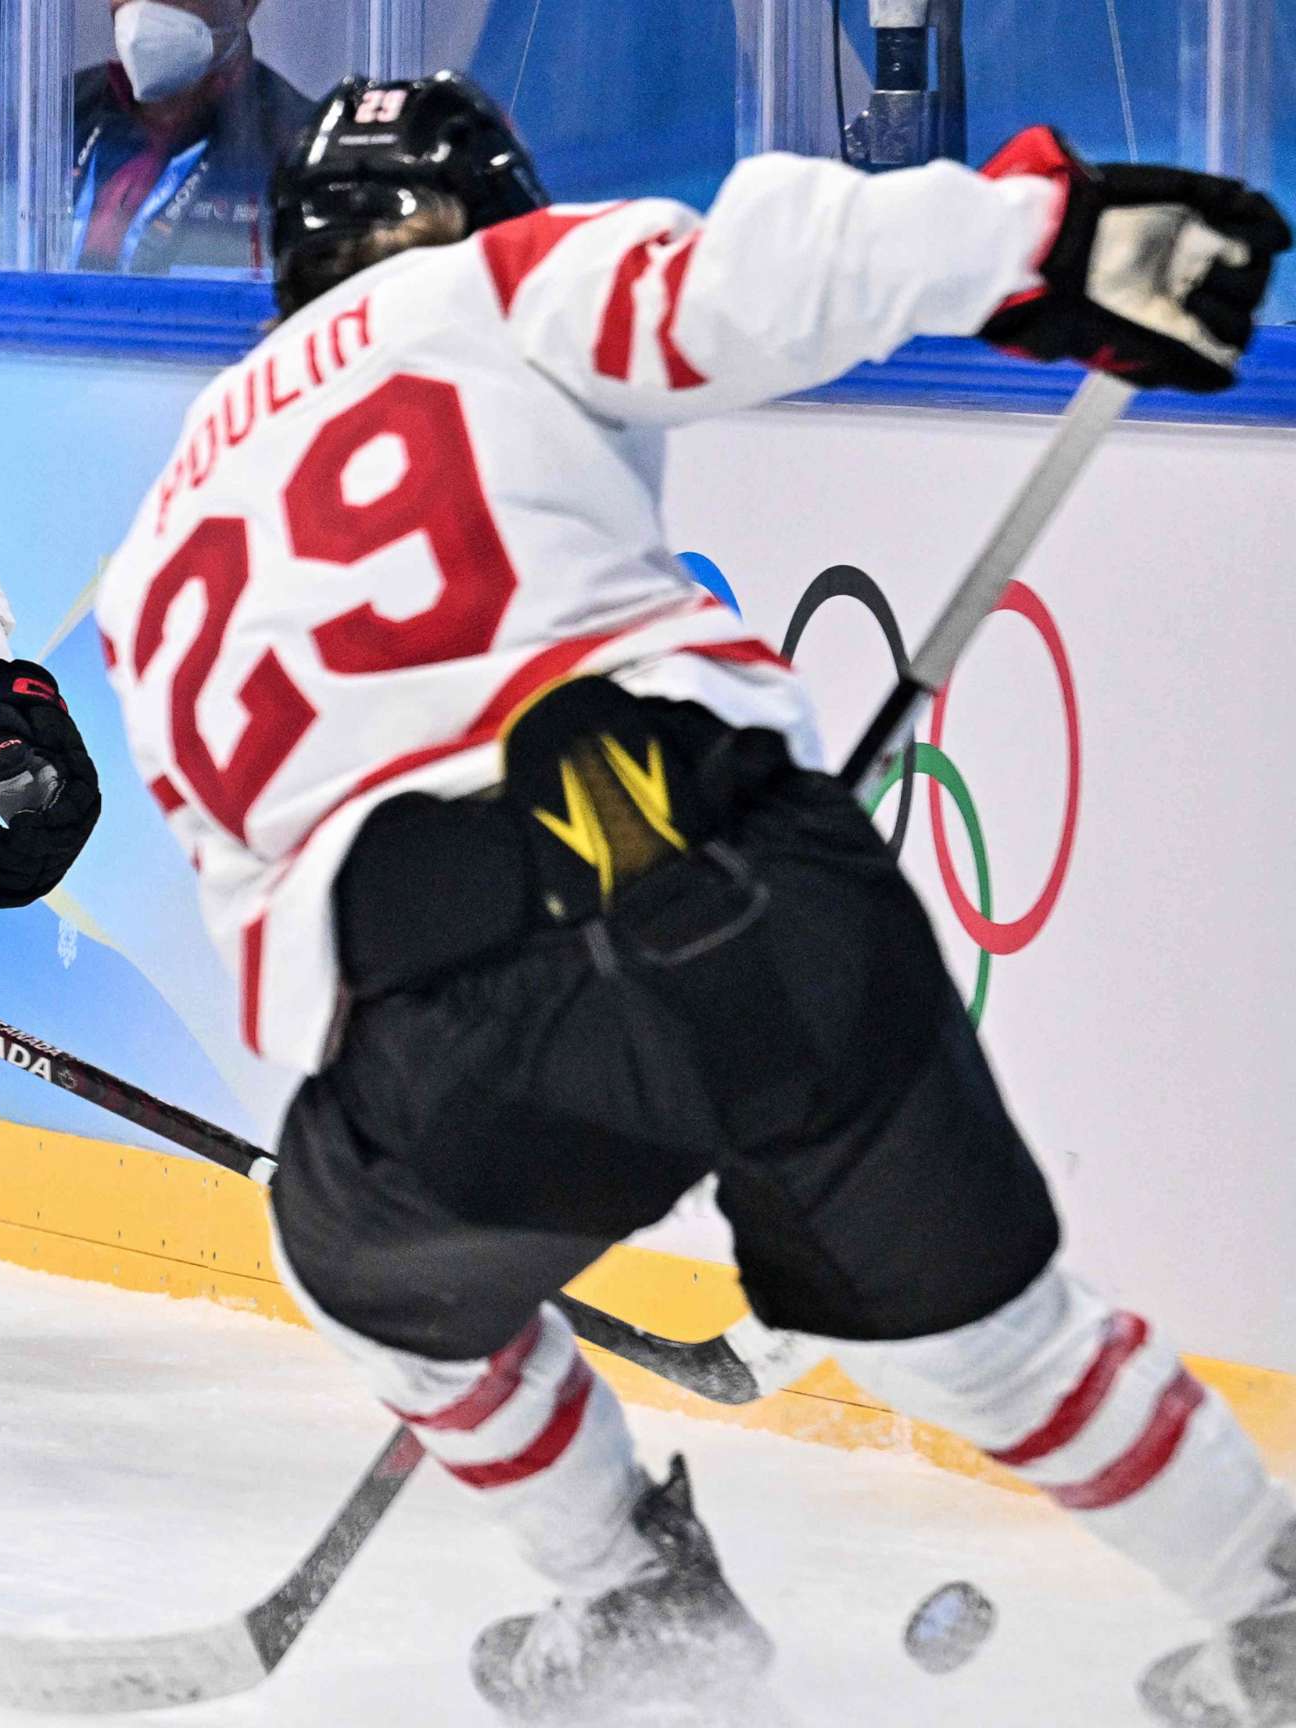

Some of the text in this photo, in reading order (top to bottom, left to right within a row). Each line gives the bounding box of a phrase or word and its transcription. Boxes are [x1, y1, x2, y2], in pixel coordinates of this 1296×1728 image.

[354, 89, 408, 124] 29
[157, 296, 372, 536] POULIN
[132, 372, 520, 848] 29
